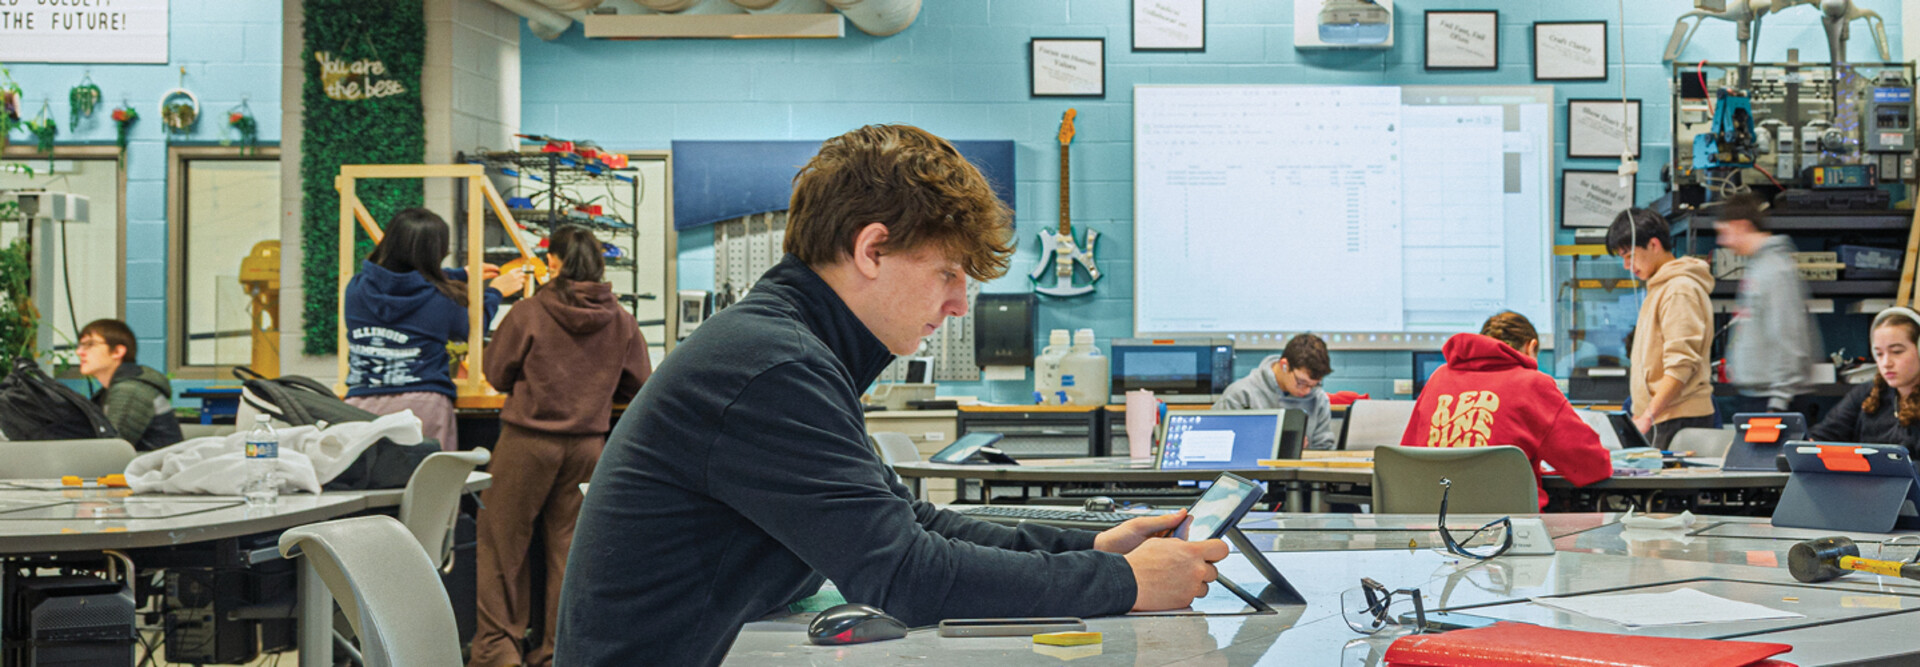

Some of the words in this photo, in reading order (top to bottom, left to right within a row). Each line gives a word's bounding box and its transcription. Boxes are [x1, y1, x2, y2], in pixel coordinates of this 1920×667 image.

[3, 12, 34, 30] THE
[51, 12, 127, 30] FUTURE!
[315, 51, 349, 79] You
[350, 59, 385, 75] are
[326, 80, 361, 99] the
[364, 76, 405, 98] best
[352, 326, 409, 345] ILLINOIS
[1431, 390, 1500, 429] RED
